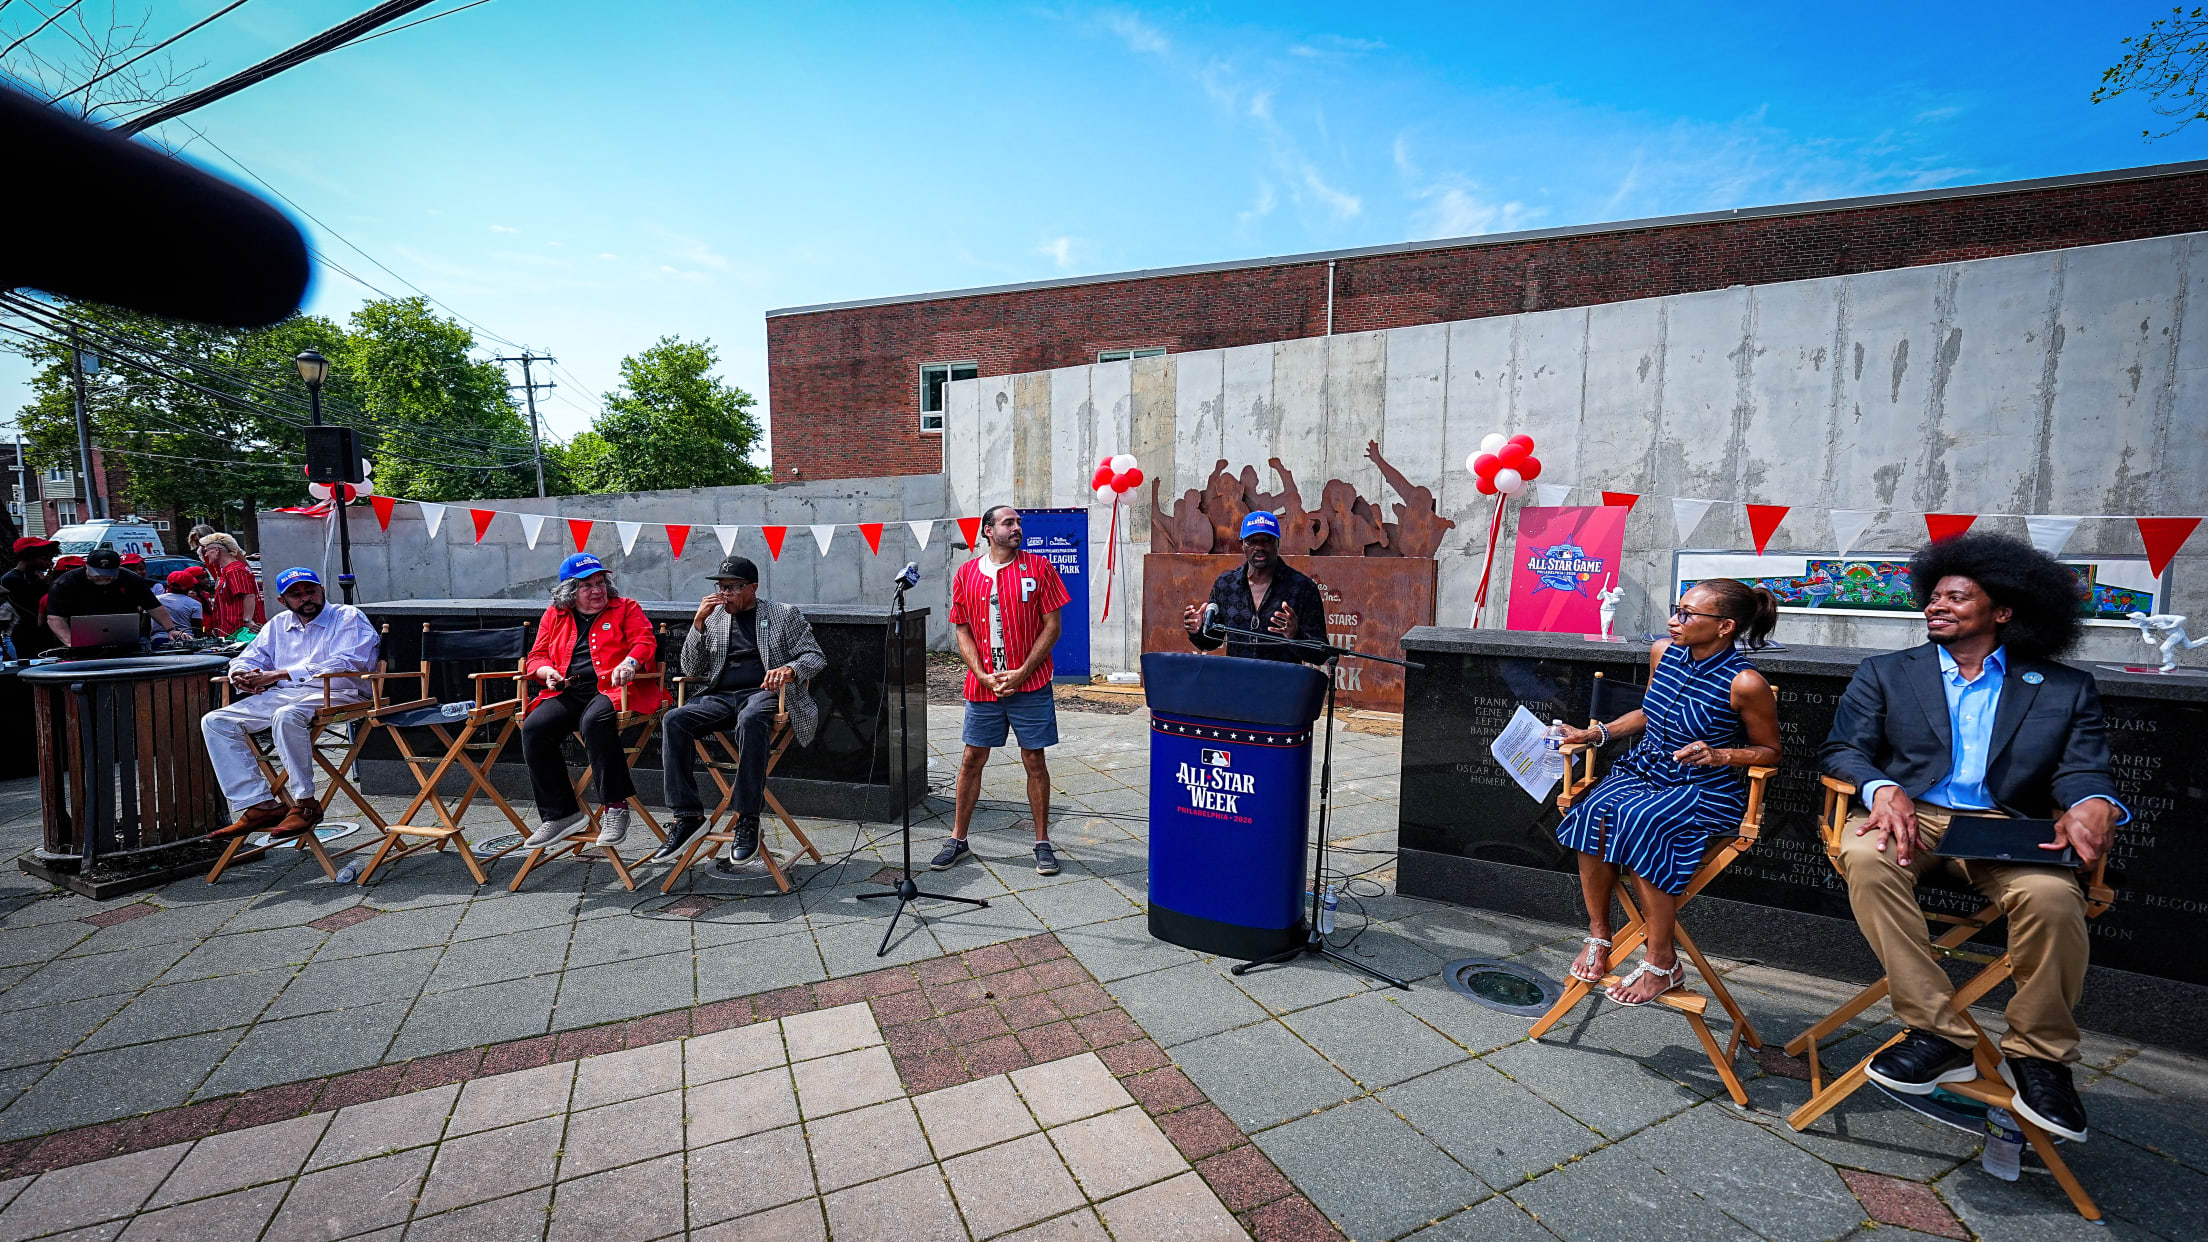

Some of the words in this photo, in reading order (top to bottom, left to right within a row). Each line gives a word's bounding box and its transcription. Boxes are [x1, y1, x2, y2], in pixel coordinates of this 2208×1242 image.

[1049, 554, 1078, 564] LEAGUE
[1527, 557, 1547, 571] ALL
[1547, 558, 1573, 571] STAR
[1573, 559, 1602, 573] GAME
[1060, 564, 1080, 574] PARK
[1021, 577, 1037, 602] P
[1328, 613, 1358, 626] STARS
[1474, 697, 1508, 708] FRANK
[1804, 693, 1823, 704] TO
[1475, 707, 1502, 718] GENE
[1475, 717, 1507, 728] LEFTY
[1779, 722, 1798, 733] VIS
[2102, 716, 2157, 732] STARS
[2109, 754, 2162, 769] ARRIS
[1456, 764, 1489, 775] OSCAR
[1780, 767, 1822, 780] CKETT
[1176, 762, 1210, 787] ALL
[1211, 767, 1255, 794] STAR
[1471, 776, 1506, 787] HOMER
[1186, 785, 1240, 814] WEEK
[2120, 794, 2174, 810] OUGH
[1177, 806, 1228, 820] PHILADELPHIA
[1233, 815, 1253, 824] 2026
[2114, 833, 2156, 848] ALM
[1761, 869, 1819, 887] LEAGUE
[2088, 923, 2133, 940] TION
